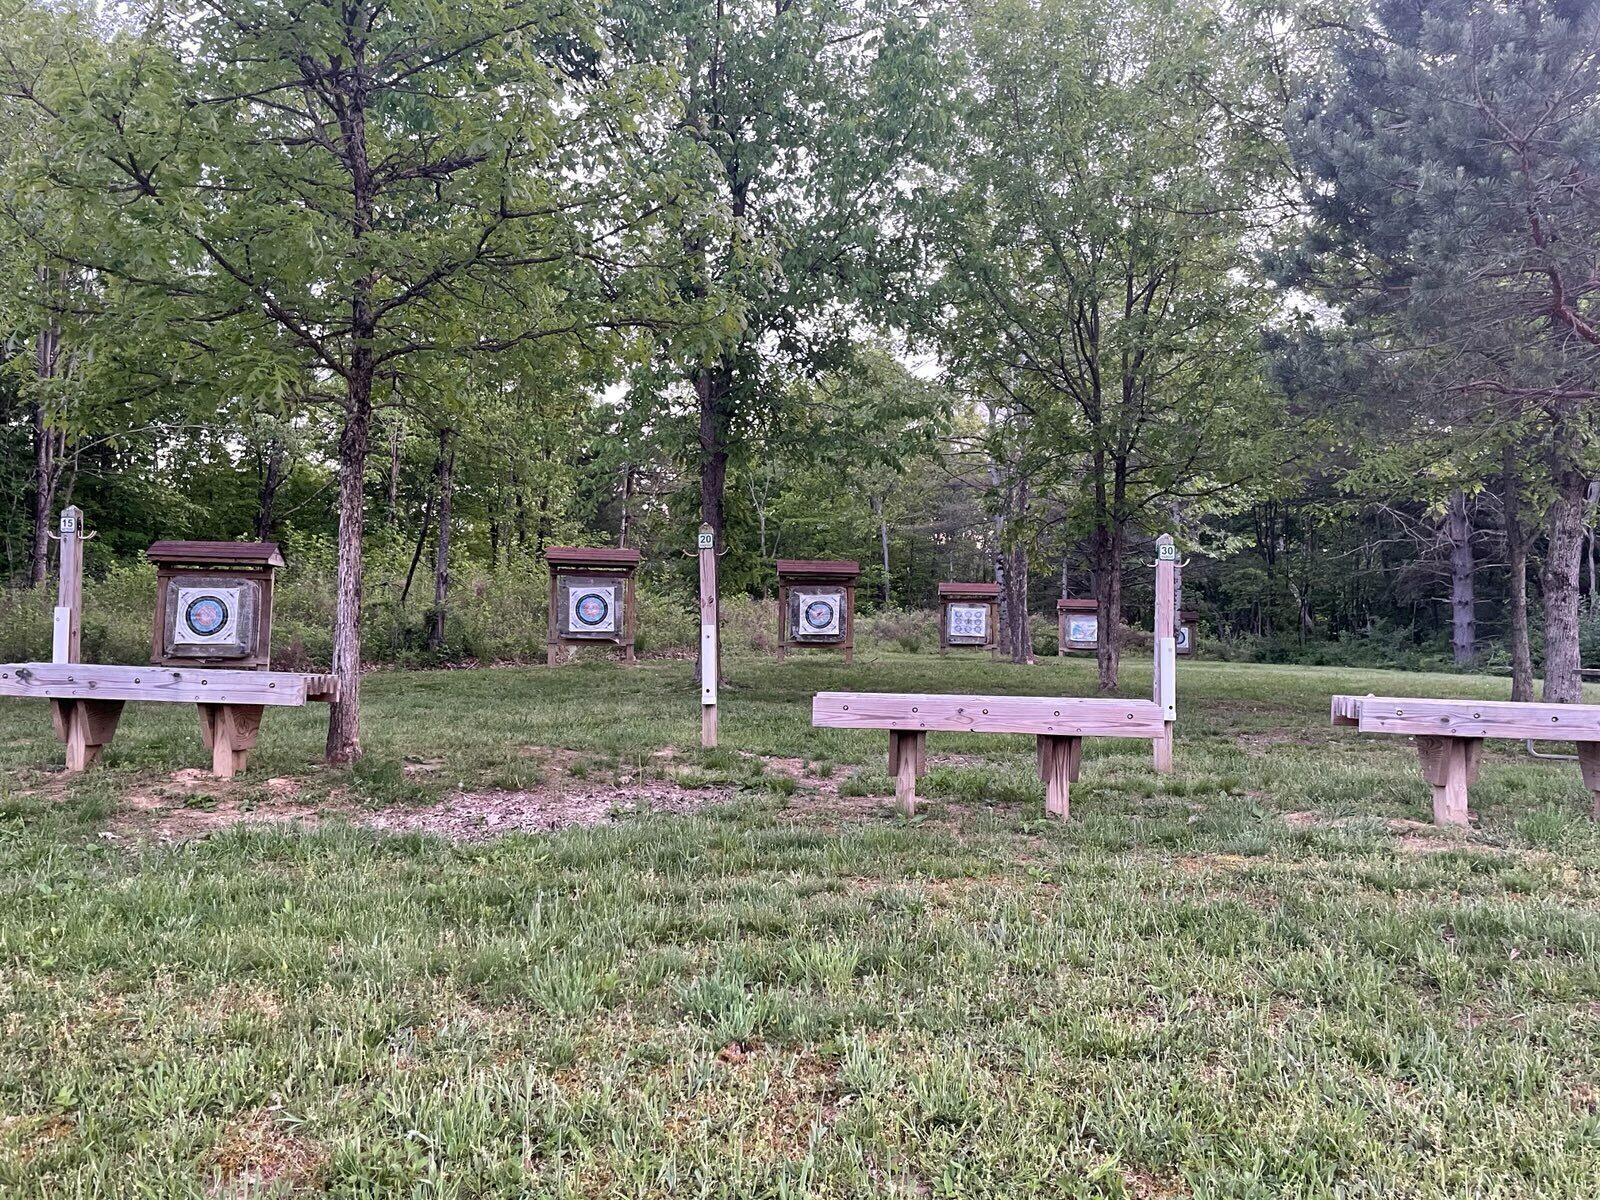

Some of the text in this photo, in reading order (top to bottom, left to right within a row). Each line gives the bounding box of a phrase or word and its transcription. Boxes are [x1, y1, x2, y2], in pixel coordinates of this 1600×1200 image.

[63, 519, 73, 527] 15
[700, 535, 711, 543] 20
[1162, 547, 1173, 555] 30
